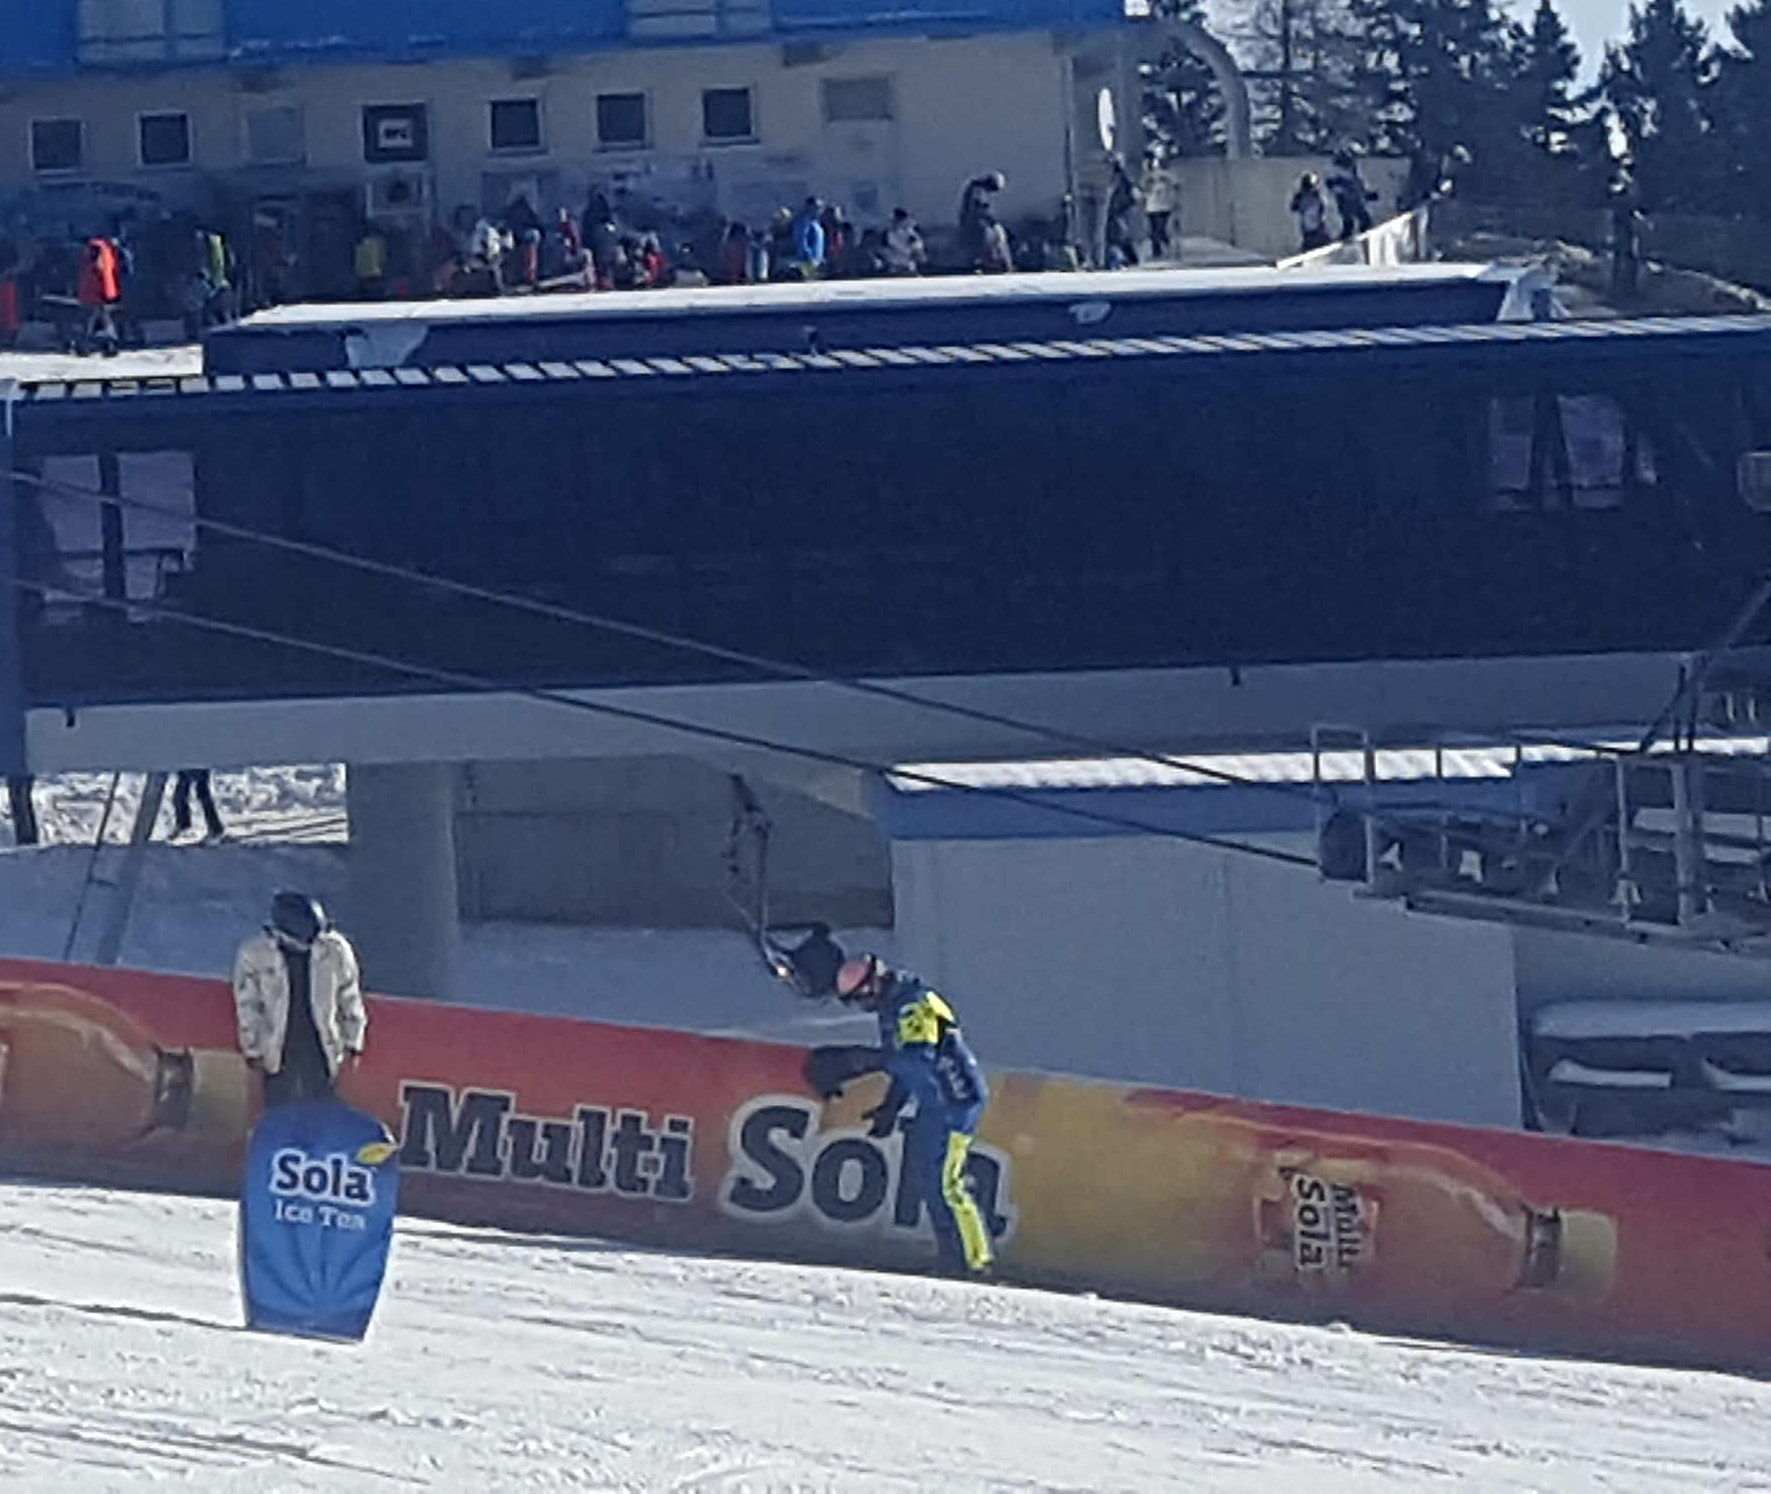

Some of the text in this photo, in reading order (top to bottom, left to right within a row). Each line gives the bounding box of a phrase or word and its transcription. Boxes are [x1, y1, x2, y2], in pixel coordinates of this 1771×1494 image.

[398, 1083, 693, 1200] Multi
[273, 1152, 372, 1203] Sola
[274, 1198, 314, 1224] Ice
[1296, 1177, 1331, 1266] Sola
